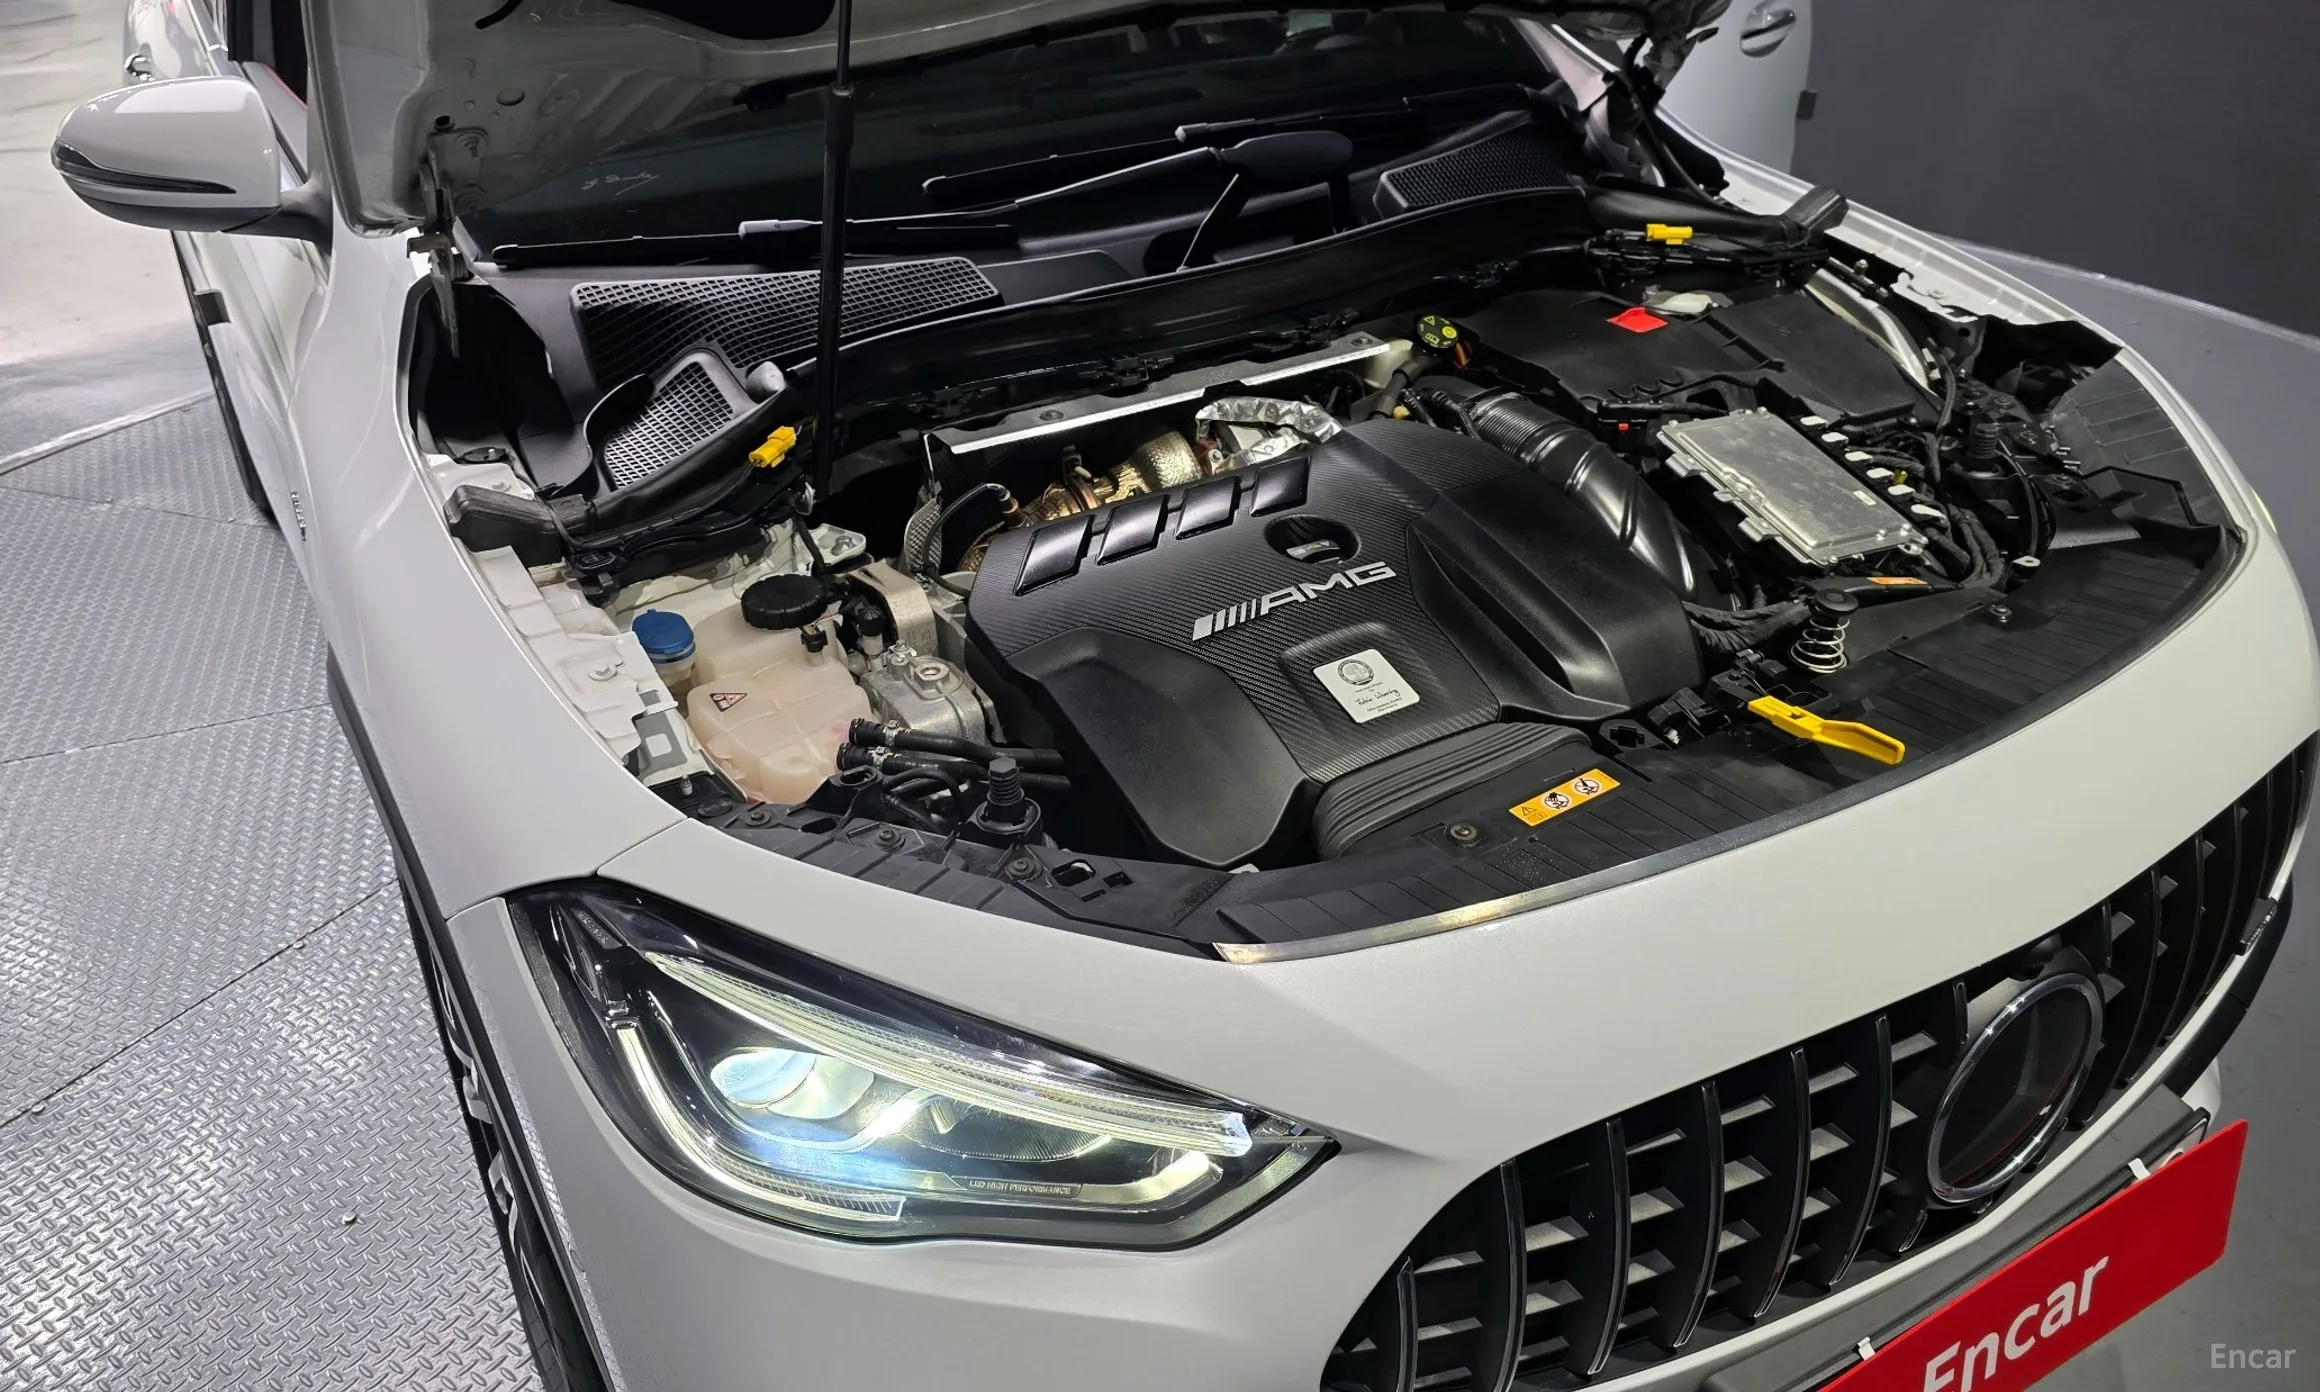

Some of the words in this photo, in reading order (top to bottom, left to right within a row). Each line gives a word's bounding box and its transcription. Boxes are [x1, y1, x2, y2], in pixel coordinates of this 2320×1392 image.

[1259, 560, 1396, 616] AMG
[987, 1181, 1008, 1192] HIGH
[1922, 1255, 2110, 1392] Encar
